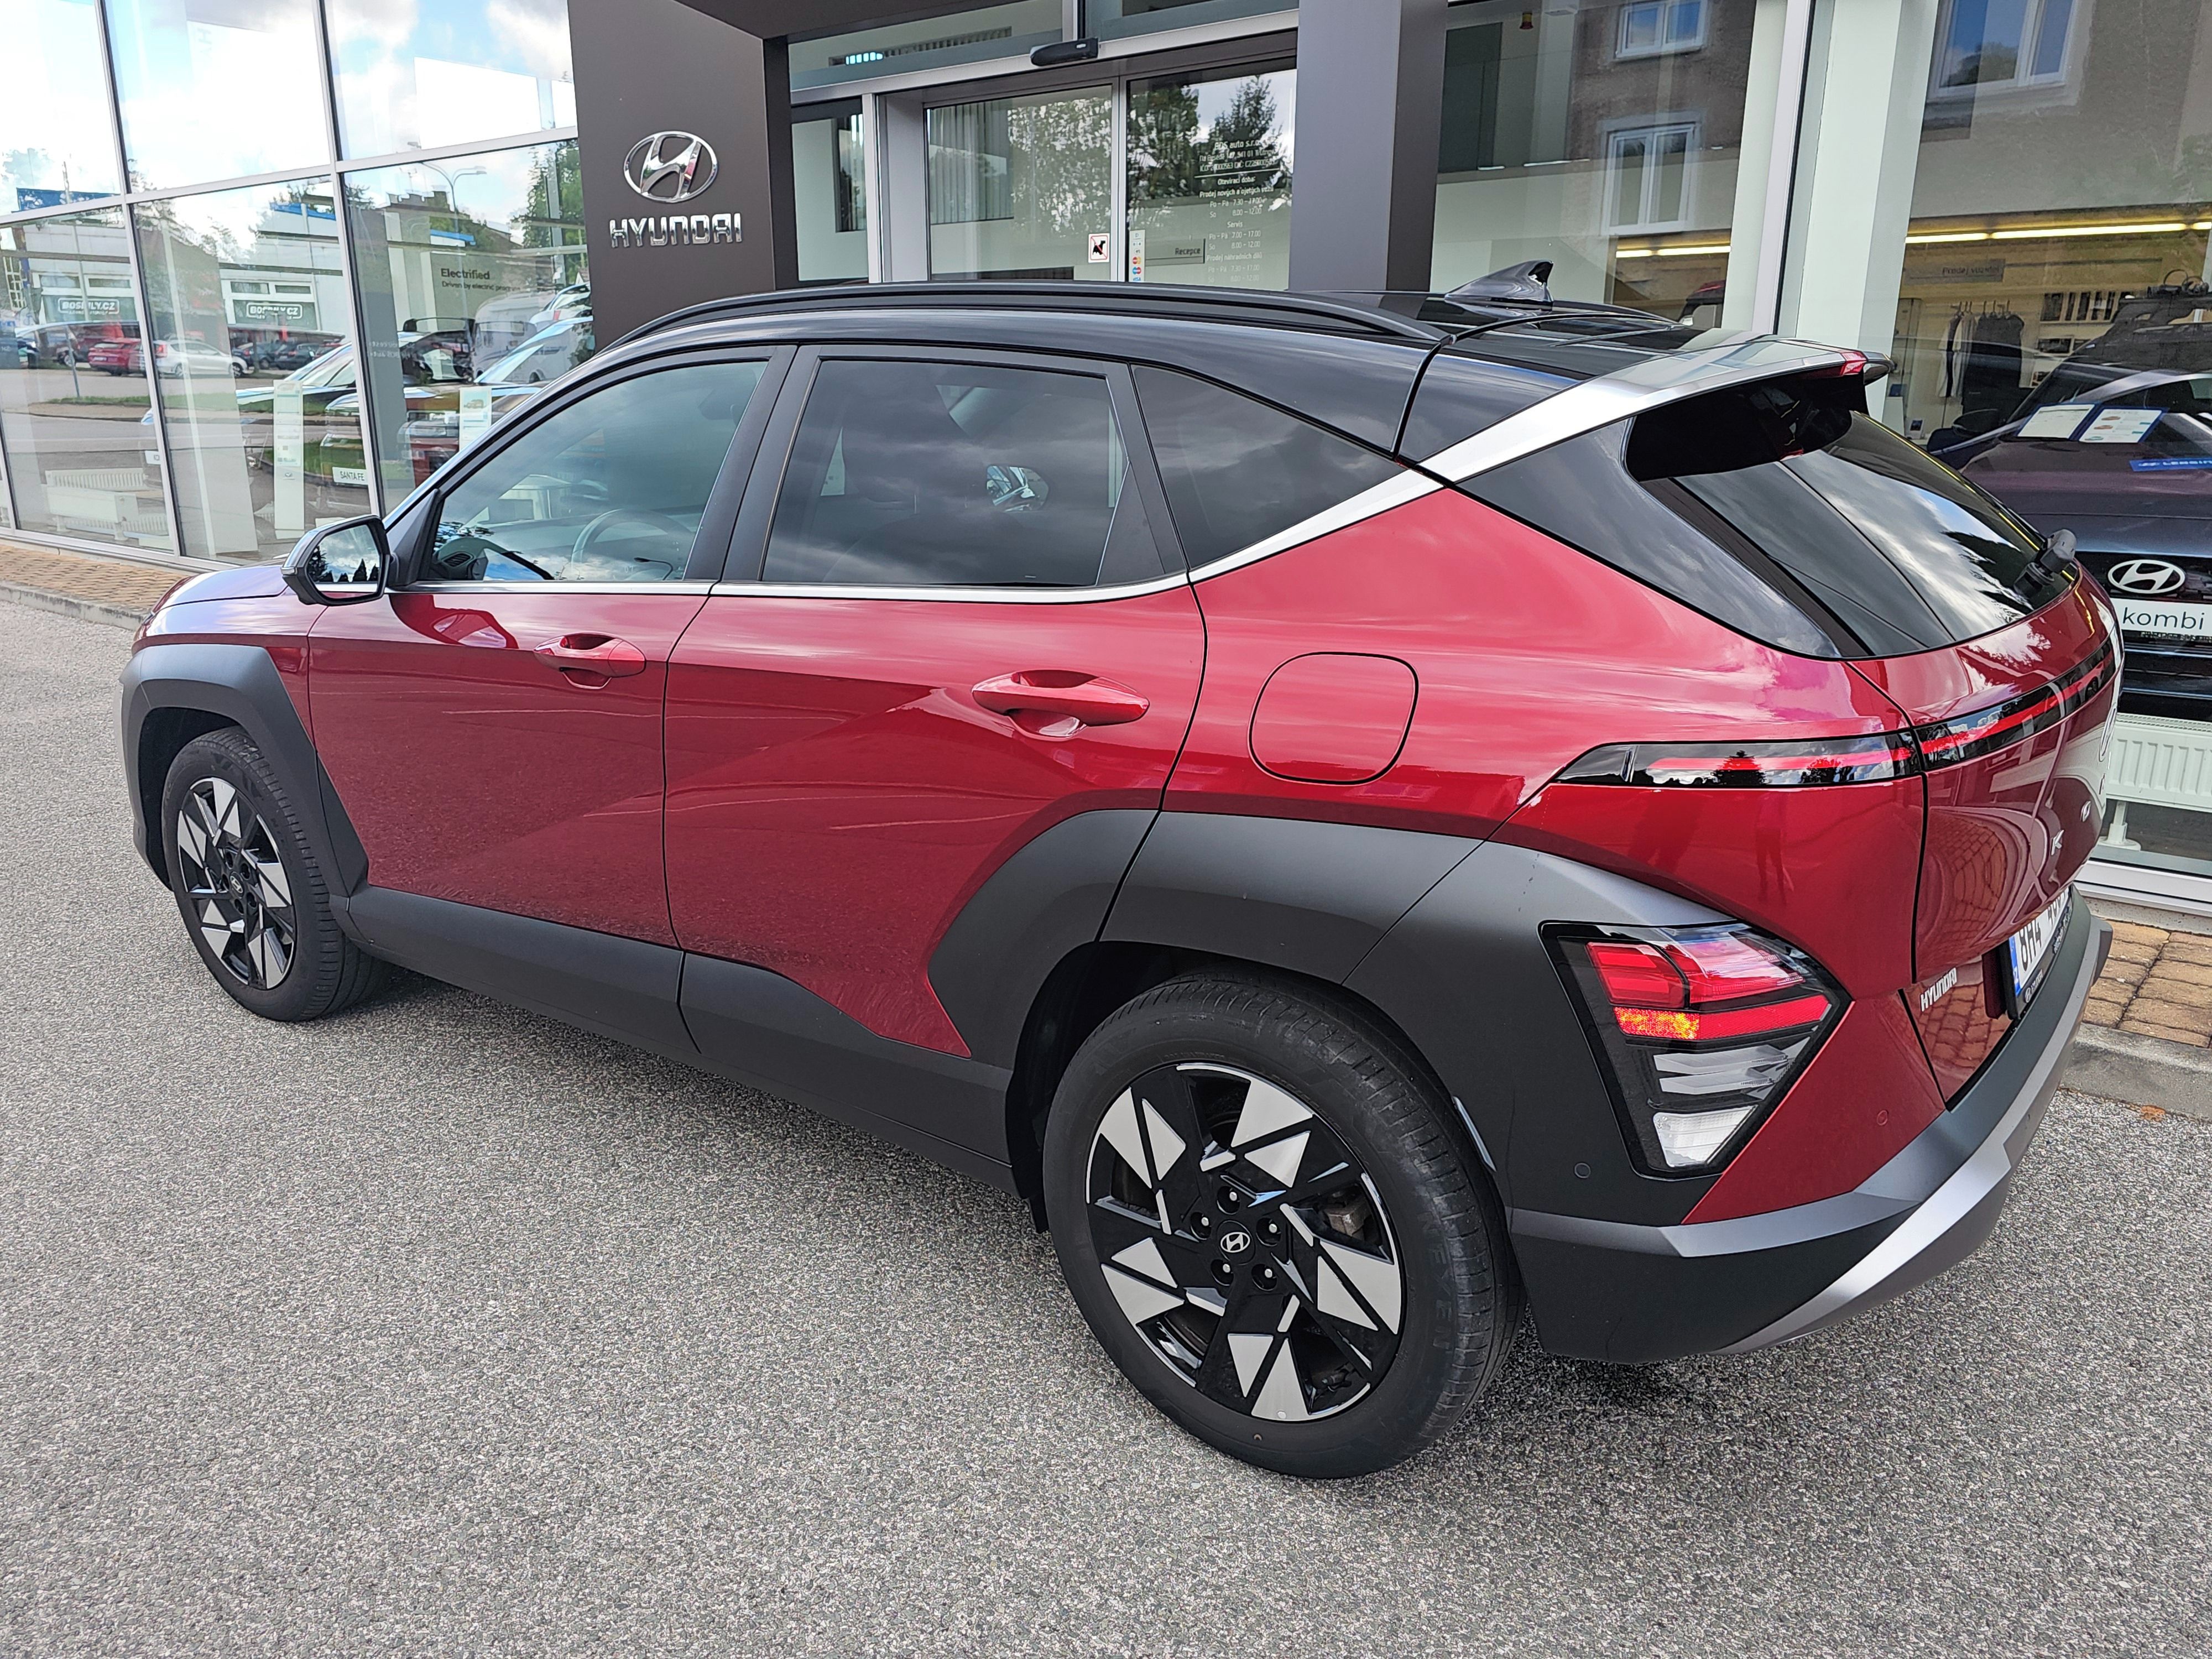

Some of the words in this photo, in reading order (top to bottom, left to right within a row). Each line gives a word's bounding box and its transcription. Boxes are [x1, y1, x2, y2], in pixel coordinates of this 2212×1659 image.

[1229, 140, 1244, 148] auto
[609, 213, 742, 248] HYUNDAI
[441, 268, 491, 280] Electrified
[2122, 606, 2205, 630] kombi
[1920, 967, 1957, 1012] HYUNDAI
[1416, 1211, 1455, 1354] NEXEN
